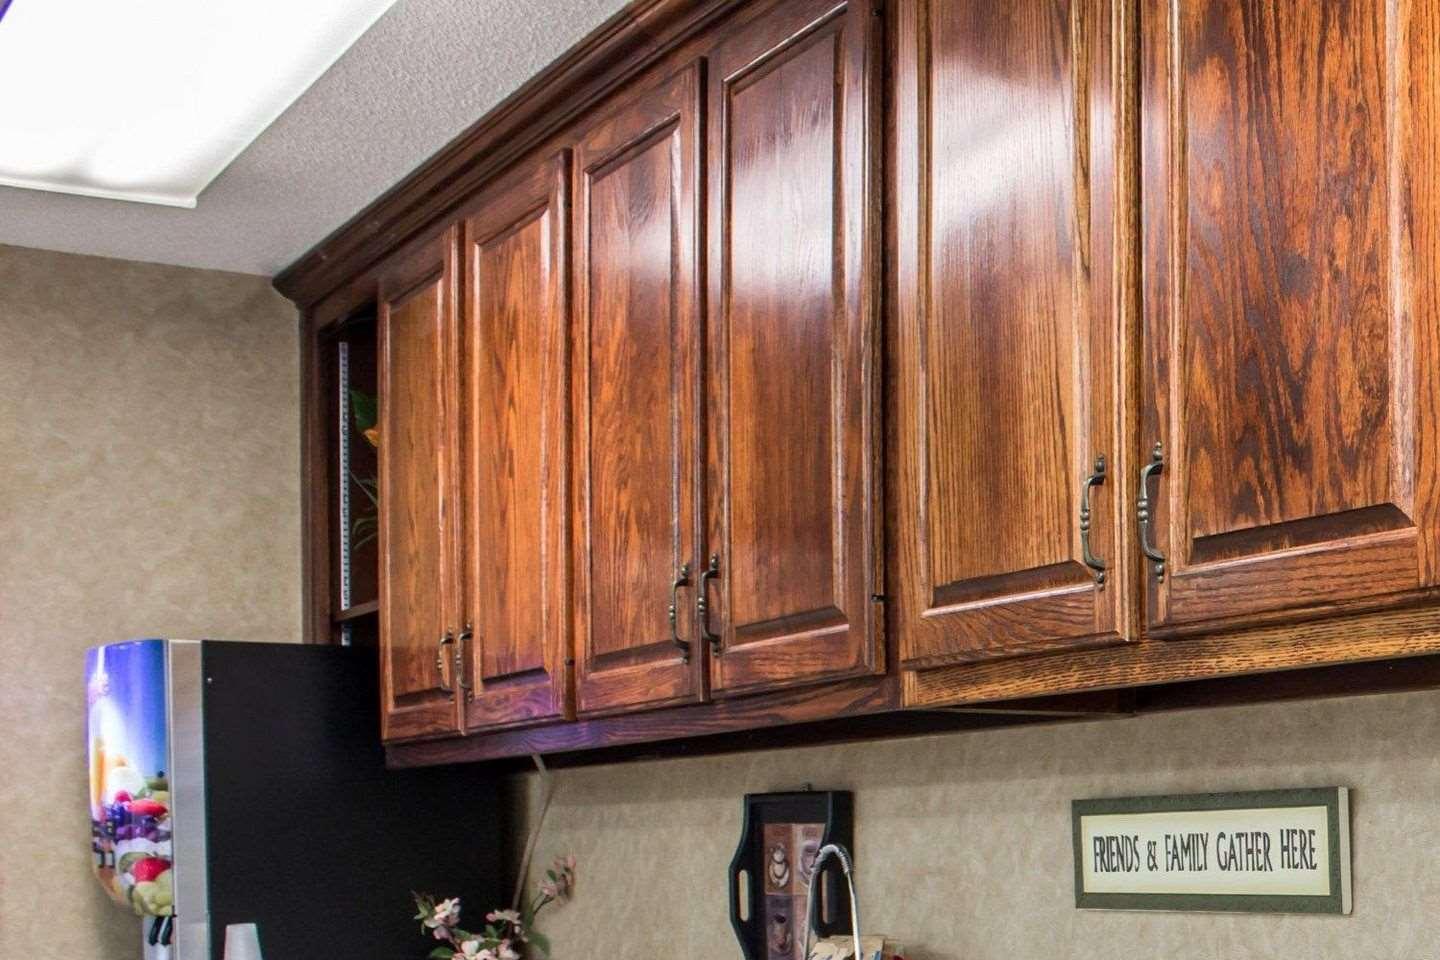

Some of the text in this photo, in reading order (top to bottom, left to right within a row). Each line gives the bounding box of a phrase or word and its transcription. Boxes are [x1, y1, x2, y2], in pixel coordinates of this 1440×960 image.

[1093, 828, 1318, 872] FRIENDS & FAMILY GATHER HERE
